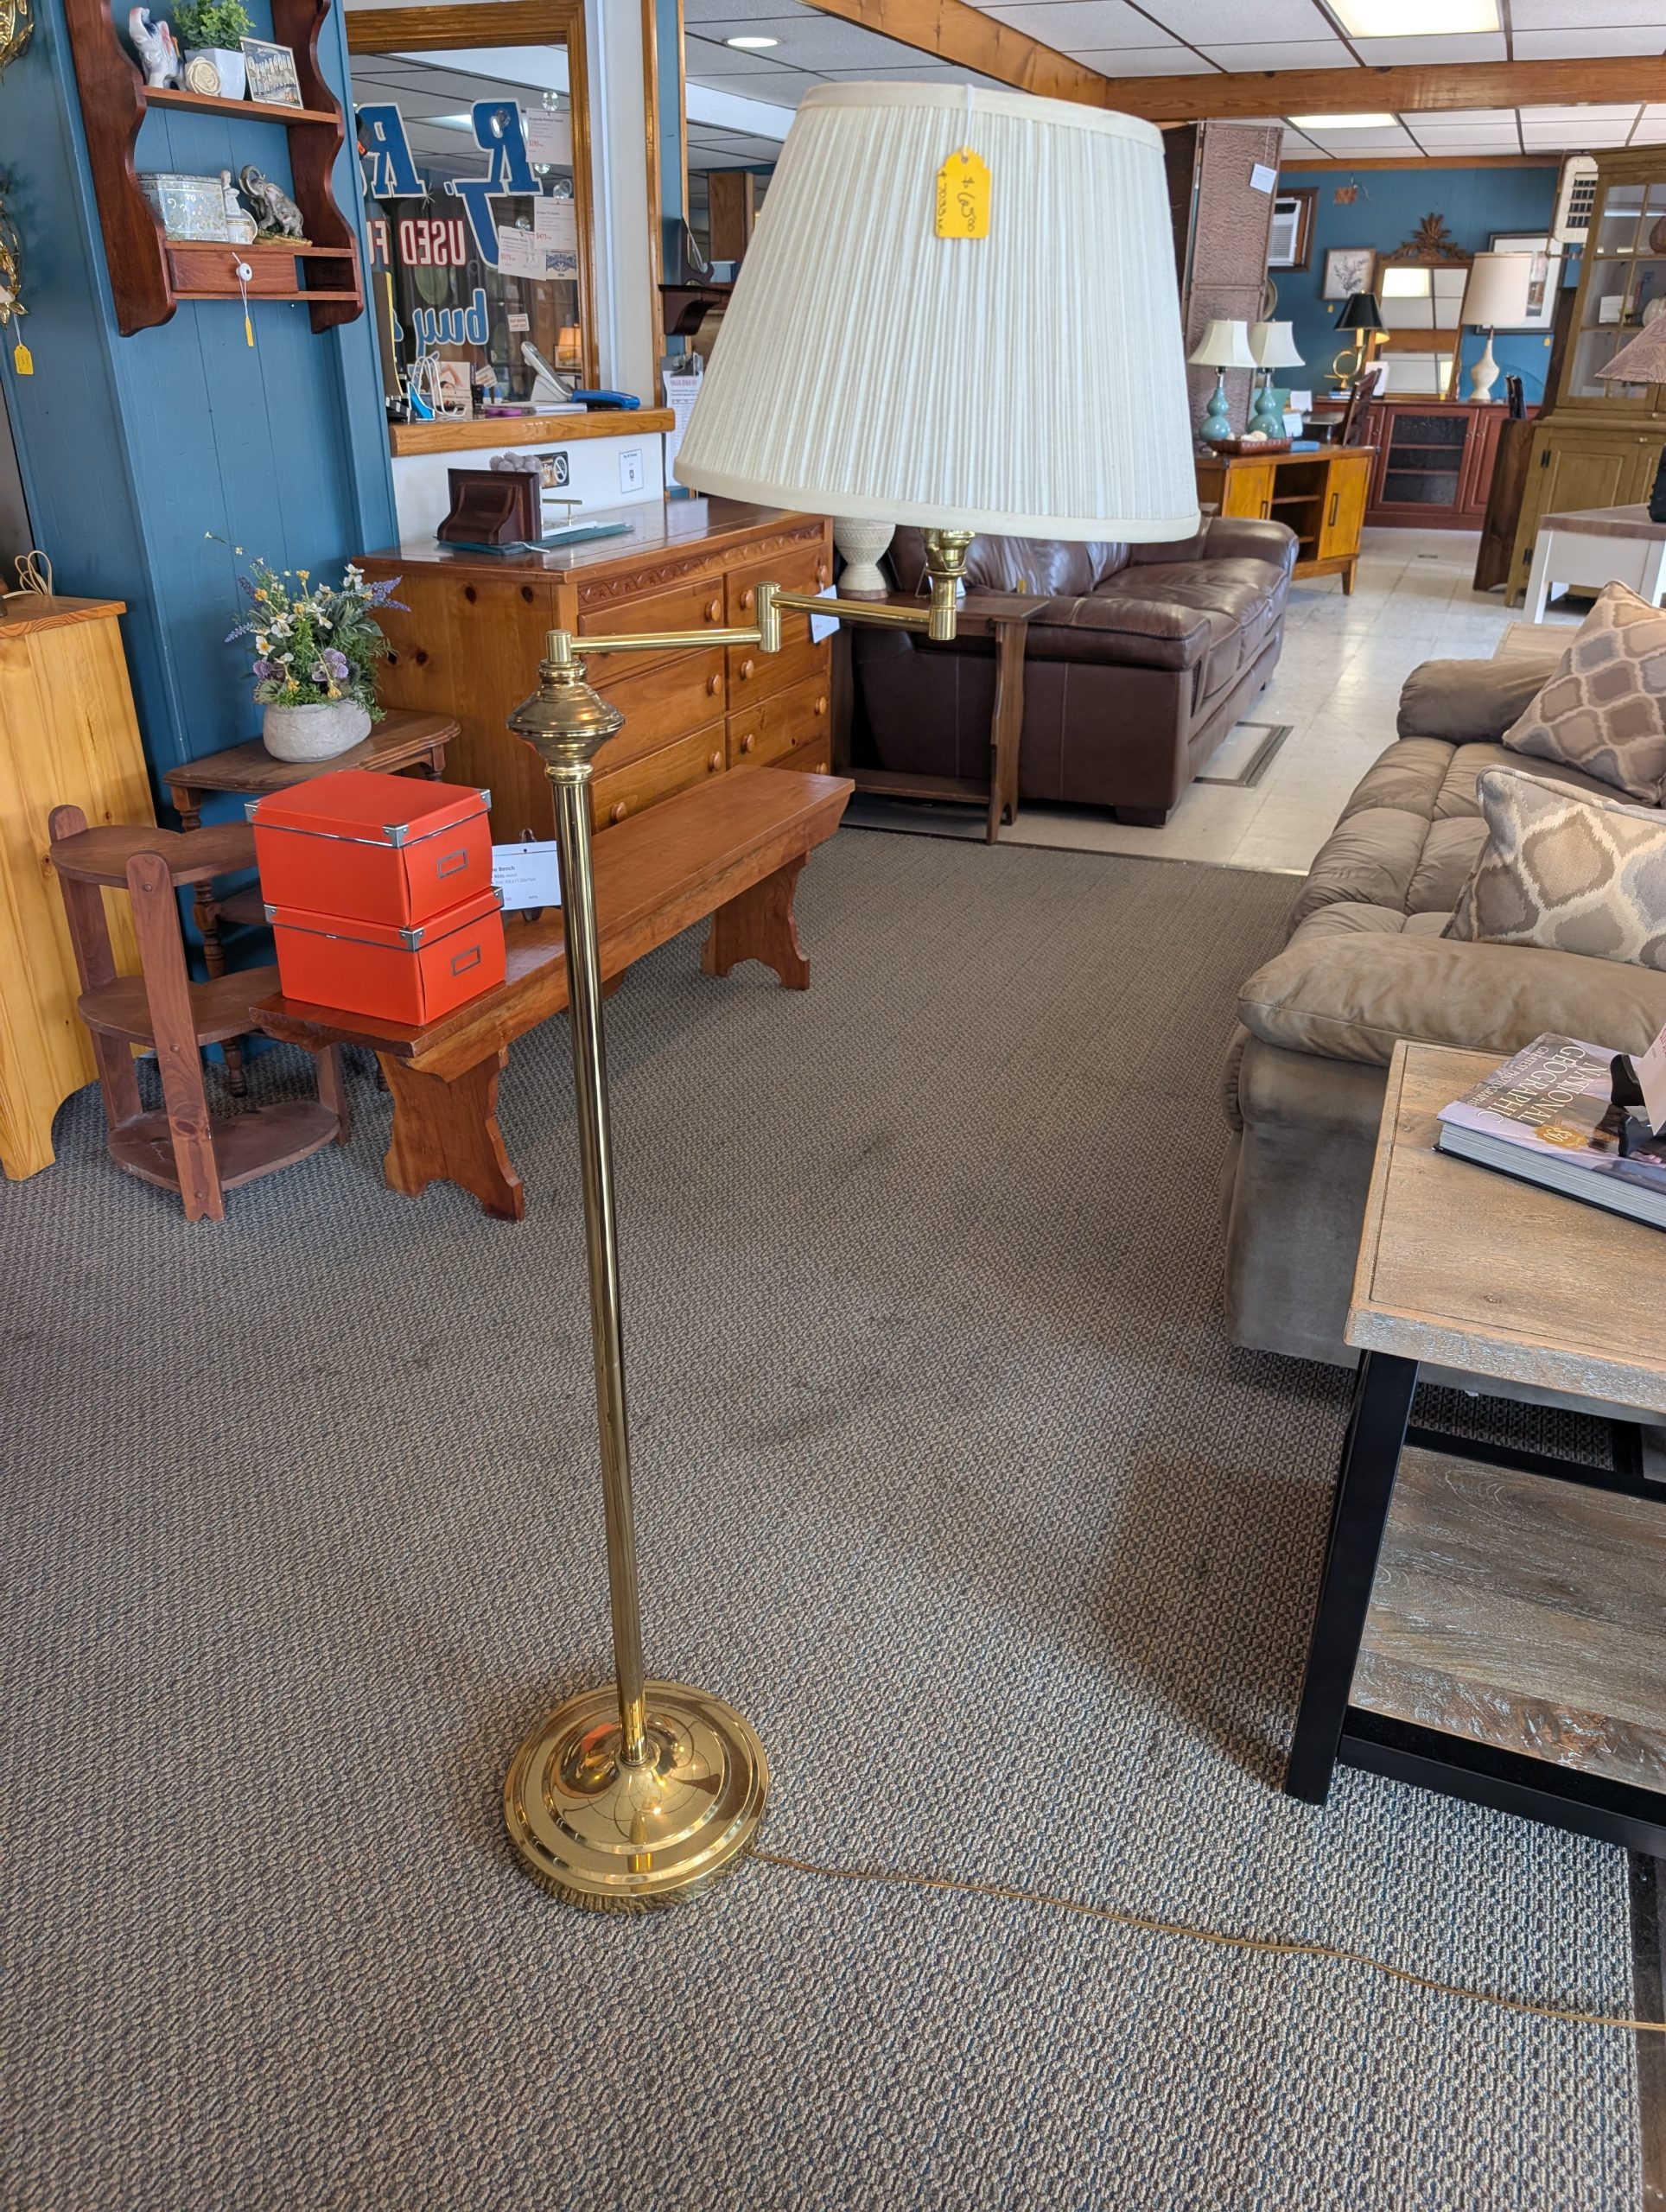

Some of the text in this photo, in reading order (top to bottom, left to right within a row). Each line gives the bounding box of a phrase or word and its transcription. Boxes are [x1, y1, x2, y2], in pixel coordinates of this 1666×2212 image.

[1468, 1046, 1549, 1107] GREATEST PHOTOGRAPHS
[1477, 1046, 1587, 1124] GEOGRAPHIC
[1517, 1061, 1608, 1125] NATIONAL
